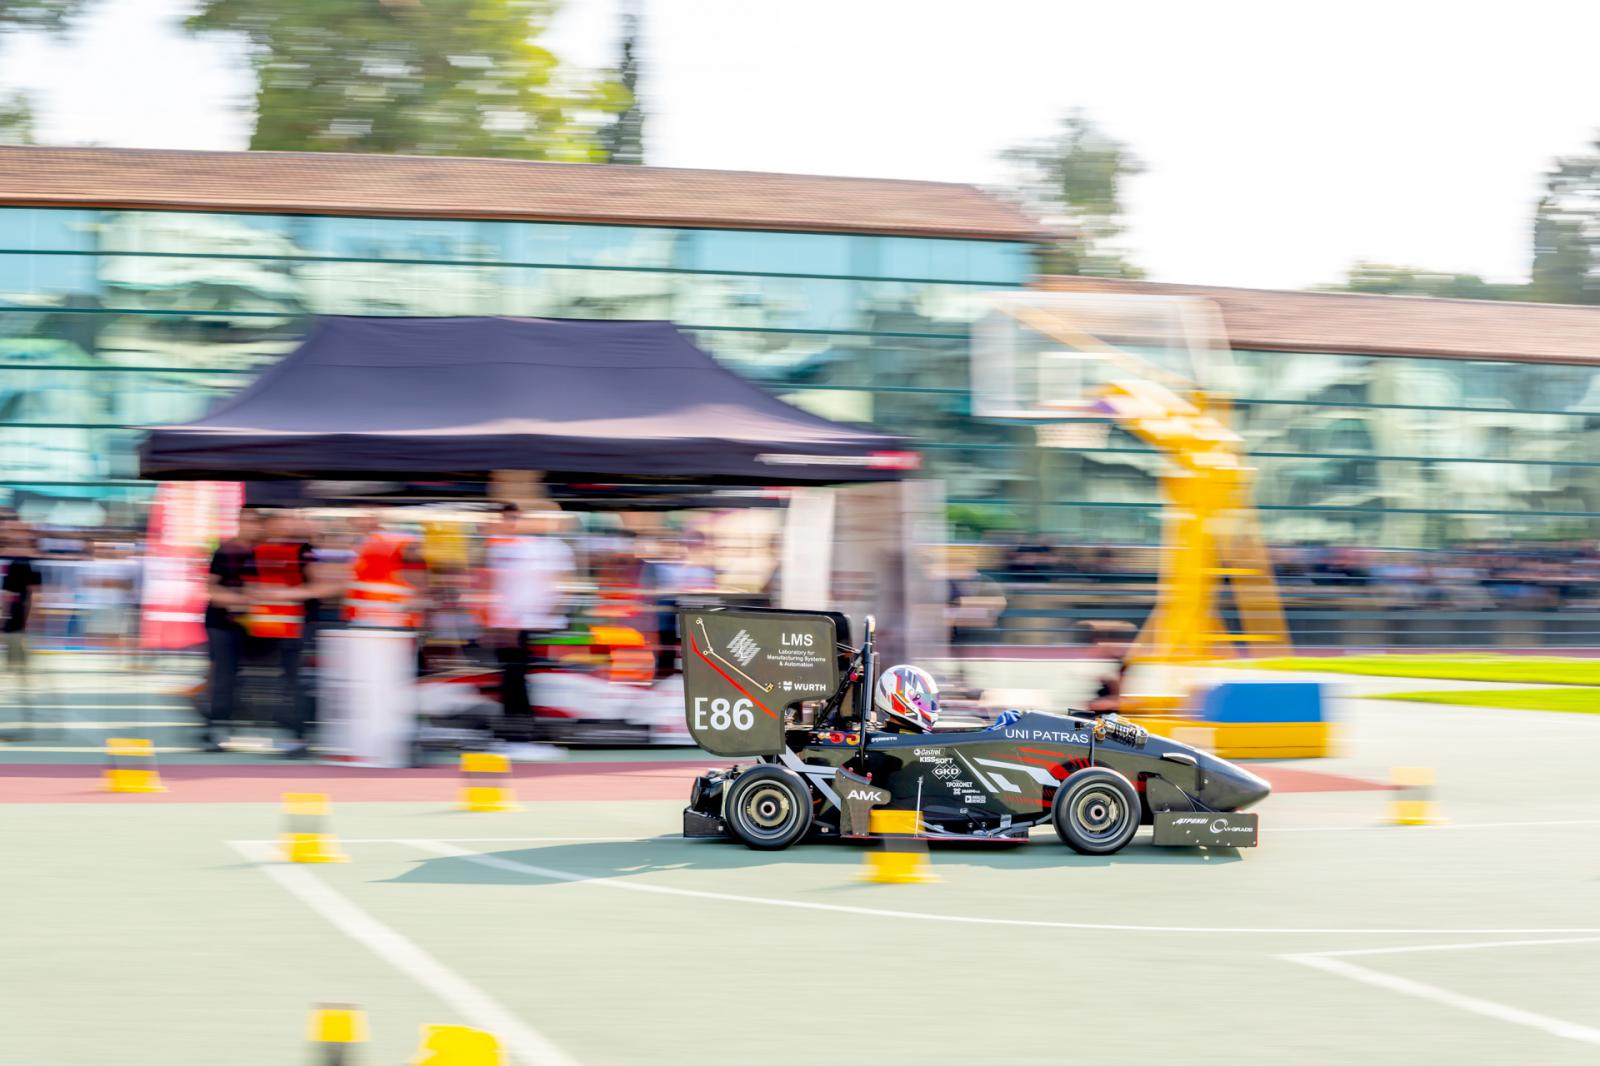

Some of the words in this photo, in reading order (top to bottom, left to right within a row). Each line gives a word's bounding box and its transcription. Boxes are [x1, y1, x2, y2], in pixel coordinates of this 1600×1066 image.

[782, 632, 814, 646] LMS
[694, 697, 754, 731] E86
[1005, 729, 1028, 739] UNI
[1033, 730, 1088, 744] PATRAS
[847, 790, 882, 801] AMK
